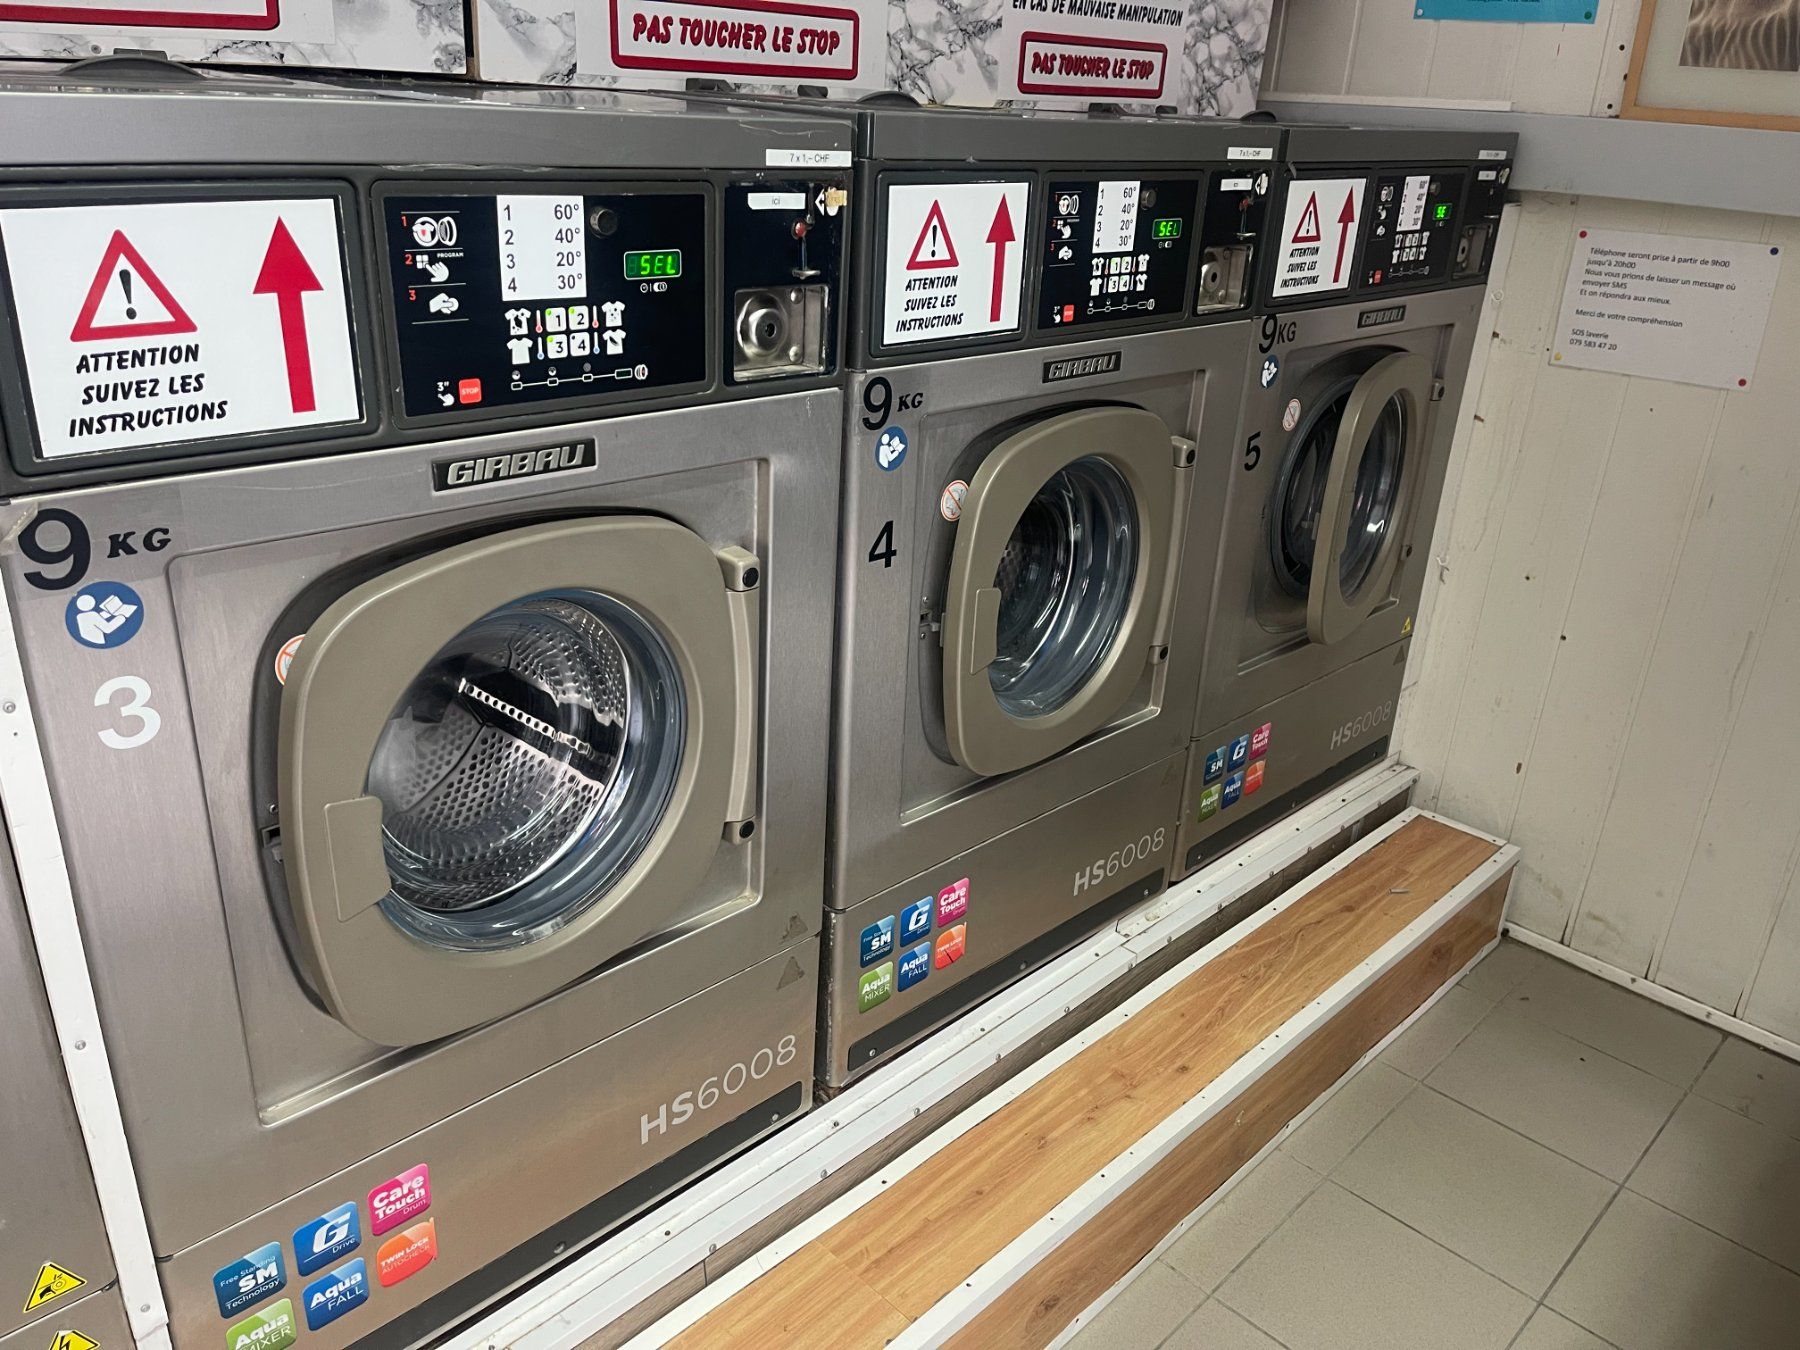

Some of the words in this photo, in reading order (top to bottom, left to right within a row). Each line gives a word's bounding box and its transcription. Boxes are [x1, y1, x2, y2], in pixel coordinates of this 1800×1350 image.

[1030, 0, 1047, 12] CAS
[1052, 0, 1066, 13] DE
[1067, 0, 1117, 19] MAUVAISE
[1118, 5, 1184, 26] MANIPULATION
[633, 13, 673, 44] PAS
[679, 18, 767, 53] TOUCHER
[772, 26, 794, 53] LE
[797, 28, 840, 55] STOP
[1031, 52, 1056, 75] PAS
[1058, 53, 1111, 79] TOUCHER
[1112, 58, 1127, 78] LE
[1127, 58, 1154, 80] STOP
[790, 153, 795, 162] 7
[814, 154, 830, 163] CHF
[1100, 188, 1105, 199] 1
[1124, 186, 1136, 198] 60°
[504, 205, 512, 221] 1
[554, 204, 579, 220] 60°
[1098, 205, 1103, 216] 2
[1122, 203, 1135, 214] 40°
[401, 216, 408, 226] 1
[1097, 222, 1102, 232] 3
[1120, 219, 1133, 231] 20°
[1158, 221, 1177, 236] SEL
[505, 230, 514, 245] 2
[555, 228, 580, 244] 40°
[1095, 238, 1100, 248] 4
[1119, 235, 1132, 247] 30°
[405, 254, 413, 264] 2
[506, 254, 516, 269] 3
[556, 251, 581, 266] 20°
[1289, 246, 1320, 258] ATTENTION
[1590, 248, 1626, 257] Téléphone
[640, 255, 676, 275] SEL
[1287, 262, 1307, 273] SUIVEZ
[1307, 261, 1317, 270] LES
[1613, 260, 1636, 268] 20h00
[508, 277, 518, 292] 4
[558, 273, 583, 290] 30°
[905, 275, 958, 291] ATTENTION
[1112, 280, 1116, 289] 3
[1280, 275, 1320, 288] INSTRUCTIONS
[1657, 275, 1679, 283] laisser
[1693, 280, 1724, 290] message
[408, 290, 416, 301] 3
[904, 296, 937, 312] SUIVEZ
[940, 294, 957, 308] LES
[1599, 292, 1631, 300] répondra
[556, 314, 562, 327] 1
[576, 313, 585, 326] 2
[896, 313, 963, 332] INSTRUCTIONS
[1576, 309, 1596, 317] Merci
[1628, 316, 1682, 327] compréhension
[1586, 330, 1609, 339] laverie
[556, 341, 564, 354] 3
[578, 338, 587, 351] 4
[76, 344, 199, 374] ATTENTION
[1049, 354, 1116, 379] GIRBAU
[82, 378, 159, 405] SUIVEZ
[169, 373, 205, 395] LES
[462, 387, 479, 396] STOP
[862, 376, 892, 430] 9
[897, 392, 923, 412] KG
[69, 400, 228, 437] INSTRUCTIONS
[1244, 431, 1261, 471] 5
[448, 444, 585, 485] GIRBAU
[18, 508, 91, 590] 9
[107, 528, 171, 558] KG
[868, 520, 897, 568] 4
[94, 675, 161, 750] 3
[1330, 700, 1392, 750] HS6008
[1233, 741, 1247, 760] G
[1074, 828, 1164, 896] HS6008
[940, 897, 966, 915] Touch
[941, 887, 966, 906] Care
[909, 905, 930, 931] G
[871, 931, 891, 950] SM
[901, 953, 928, 973] Aqua
[909, 964, 927, 978] FALL
[862, 974, 890, 995] Aqua
[865, 984, 890, 1002] MIXER
[641, 1035, 796, 1145] HS6008
[373, 1175, 424, 1208] Care
[375, 1187, 426, 1220] Touch
[404, 1199, 426, 1214] Drum
[313, 1212, 351, 1253] G
[333, 1237, 355, 1254] Drive
[381, 1250, 405, 1266] TWIN
[406, 1237, 428, 1253] LOCK
[382, 1244, 429, 1274] AUTOCHECK
[220, 1274, 239, 1287] Free
[240, 1256, 276, 1275] Standing
[238, 1262, 278, 1292] SM
[226, 1278, 280, 1310] Technology
[310, 1271, 362, 1308] Aqua
[328, 1286, 364, 1311] FALL
[235, 1314, 289, 1350] Aqua
